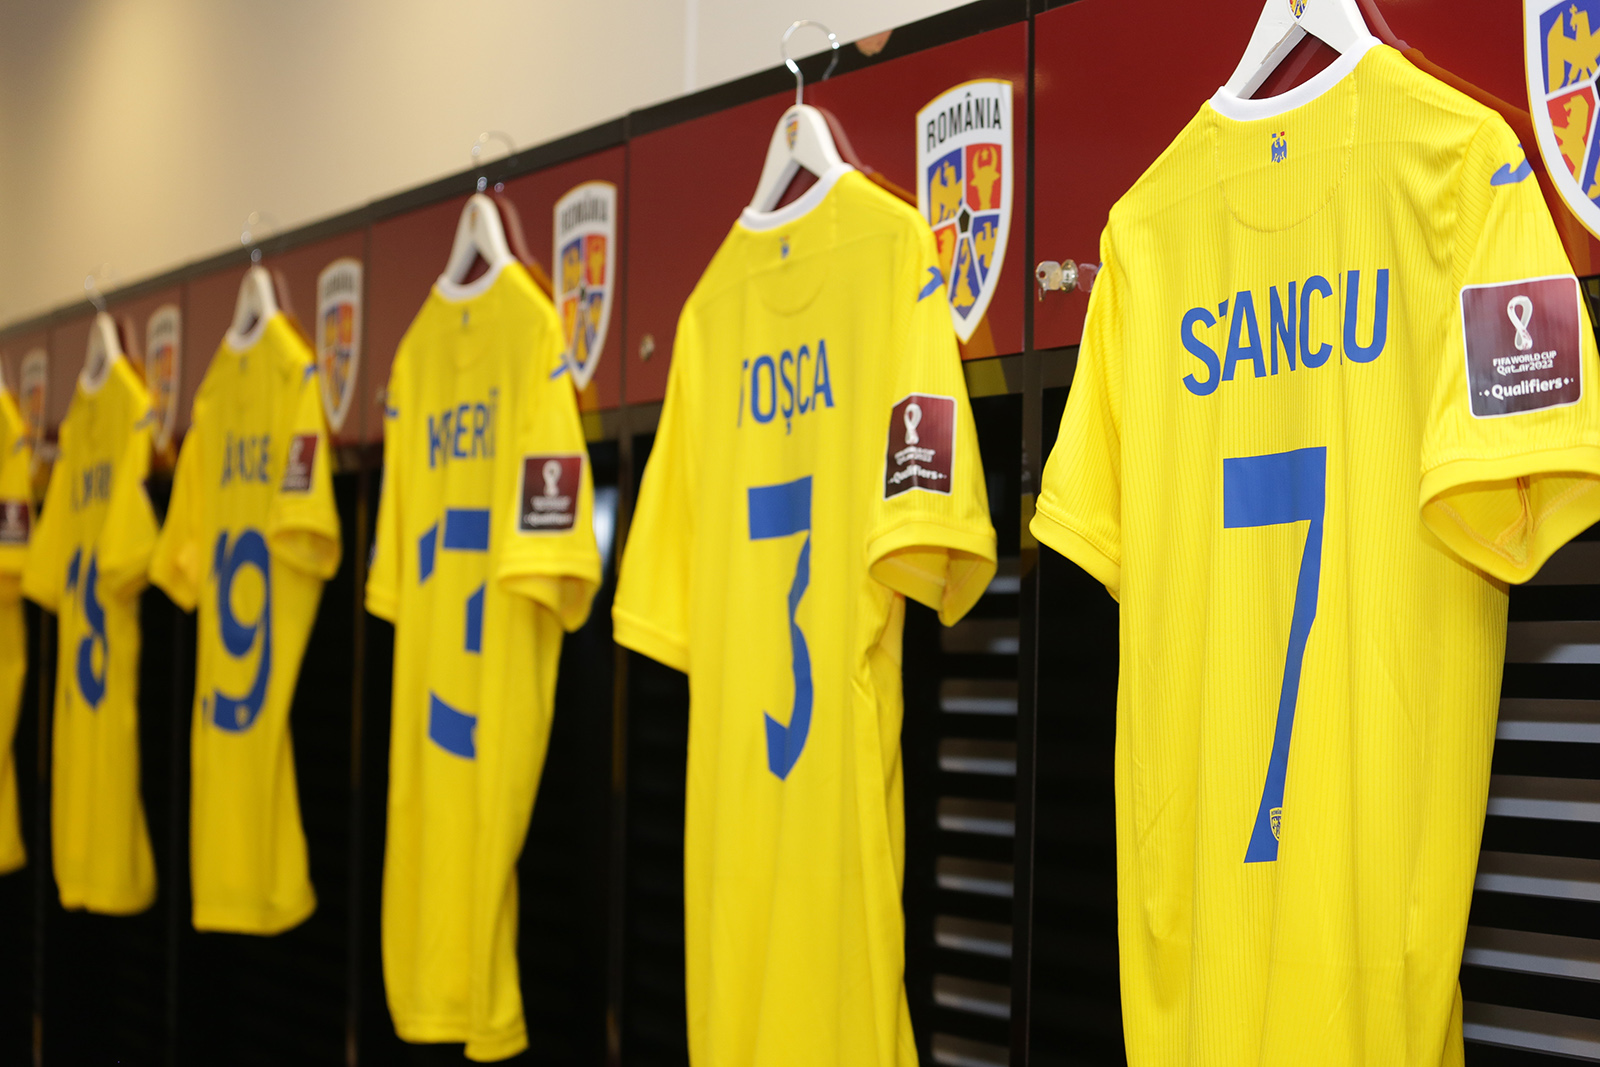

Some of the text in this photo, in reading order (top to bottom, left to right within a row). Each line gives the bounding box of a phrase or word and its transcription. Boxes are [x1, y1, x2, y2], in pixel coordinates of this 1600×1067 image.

[927, 91, 1002, 154] ROMÂNIA
[1180, 268, 1389, 396] SANCU
[1493, 350, 1557, 367] FIFA WORLD CUP
[737, 338, 834, 435] OȘCA
[1491, 377, 1563, 400] Qualifiers
[747, 475, 814, 782] 3
[1223, 446, 1327, 863] 7
